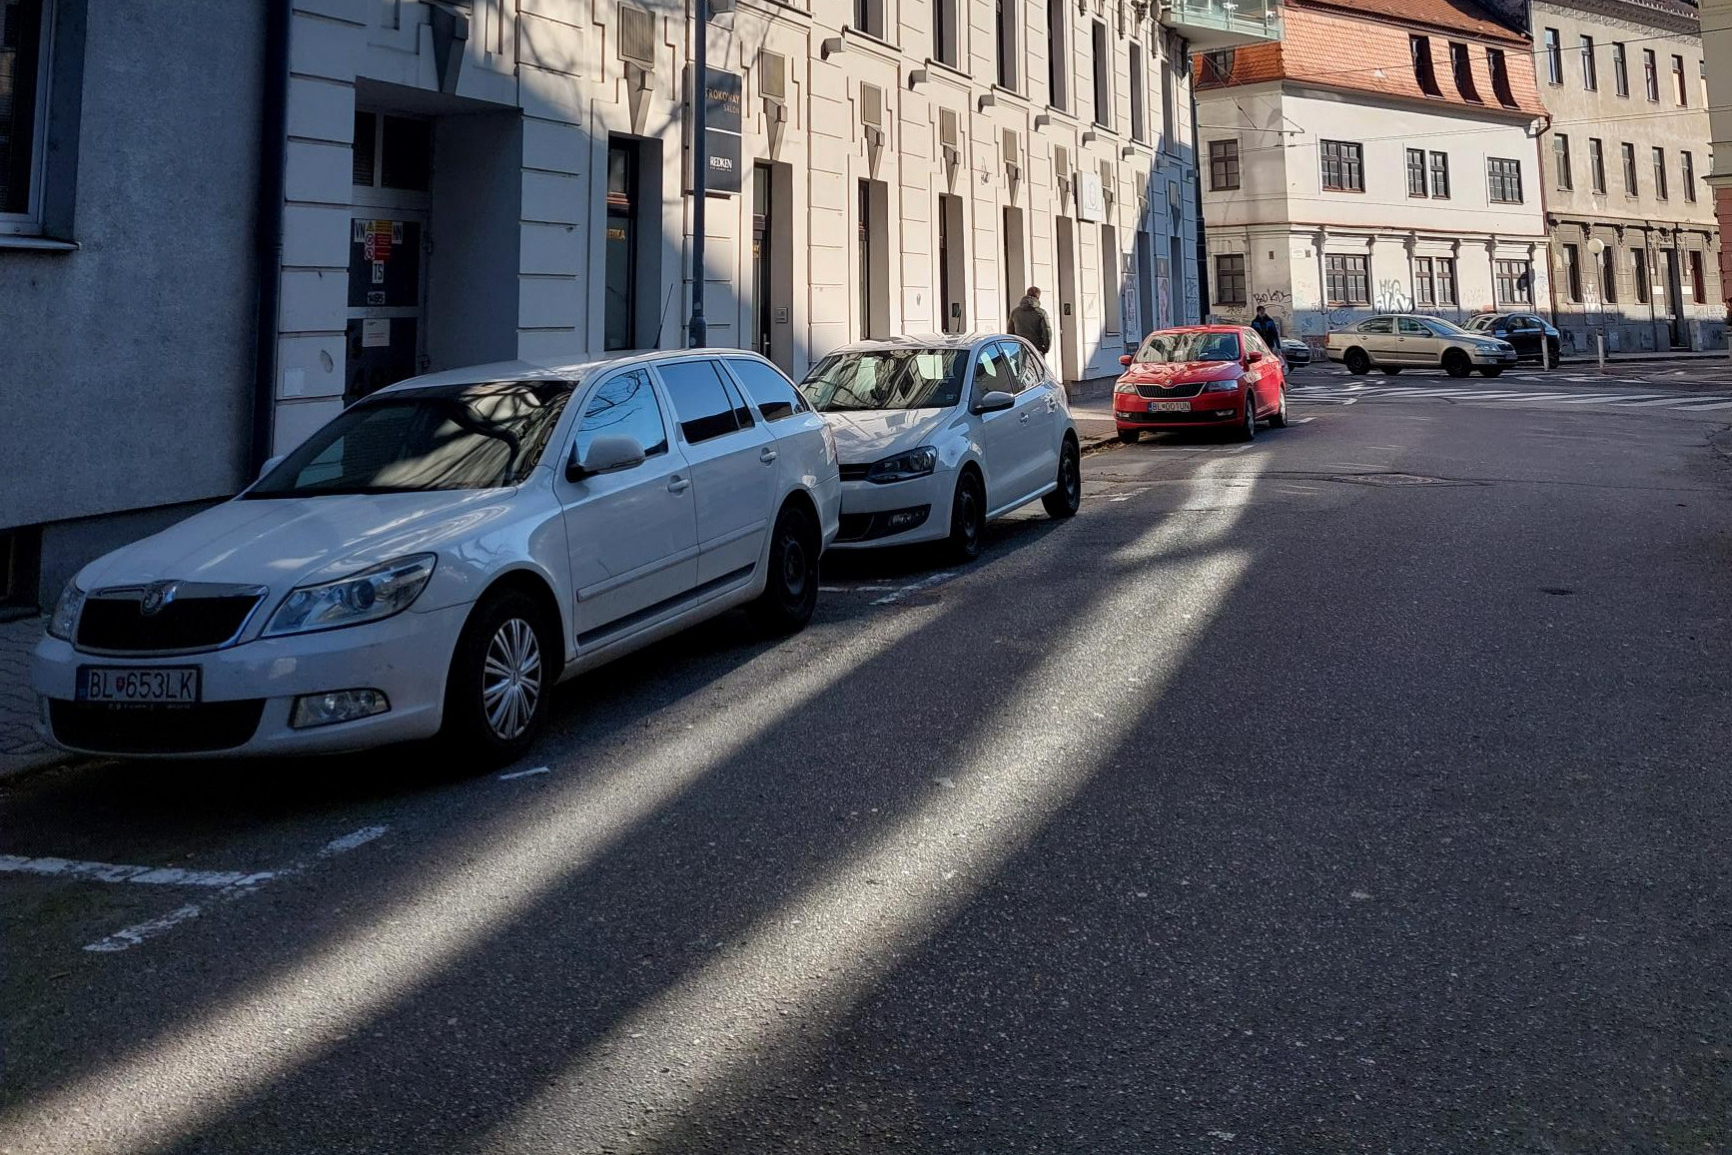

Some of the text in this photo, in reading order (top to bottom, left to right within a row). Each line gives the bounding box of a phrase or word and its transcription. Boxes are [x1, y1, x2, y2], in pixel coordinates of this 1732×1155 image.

[709, 156, 733, 169] REDKEN
[374, 263, 383, 281] TS
[90, 672, 193, 699] BL 653LK
